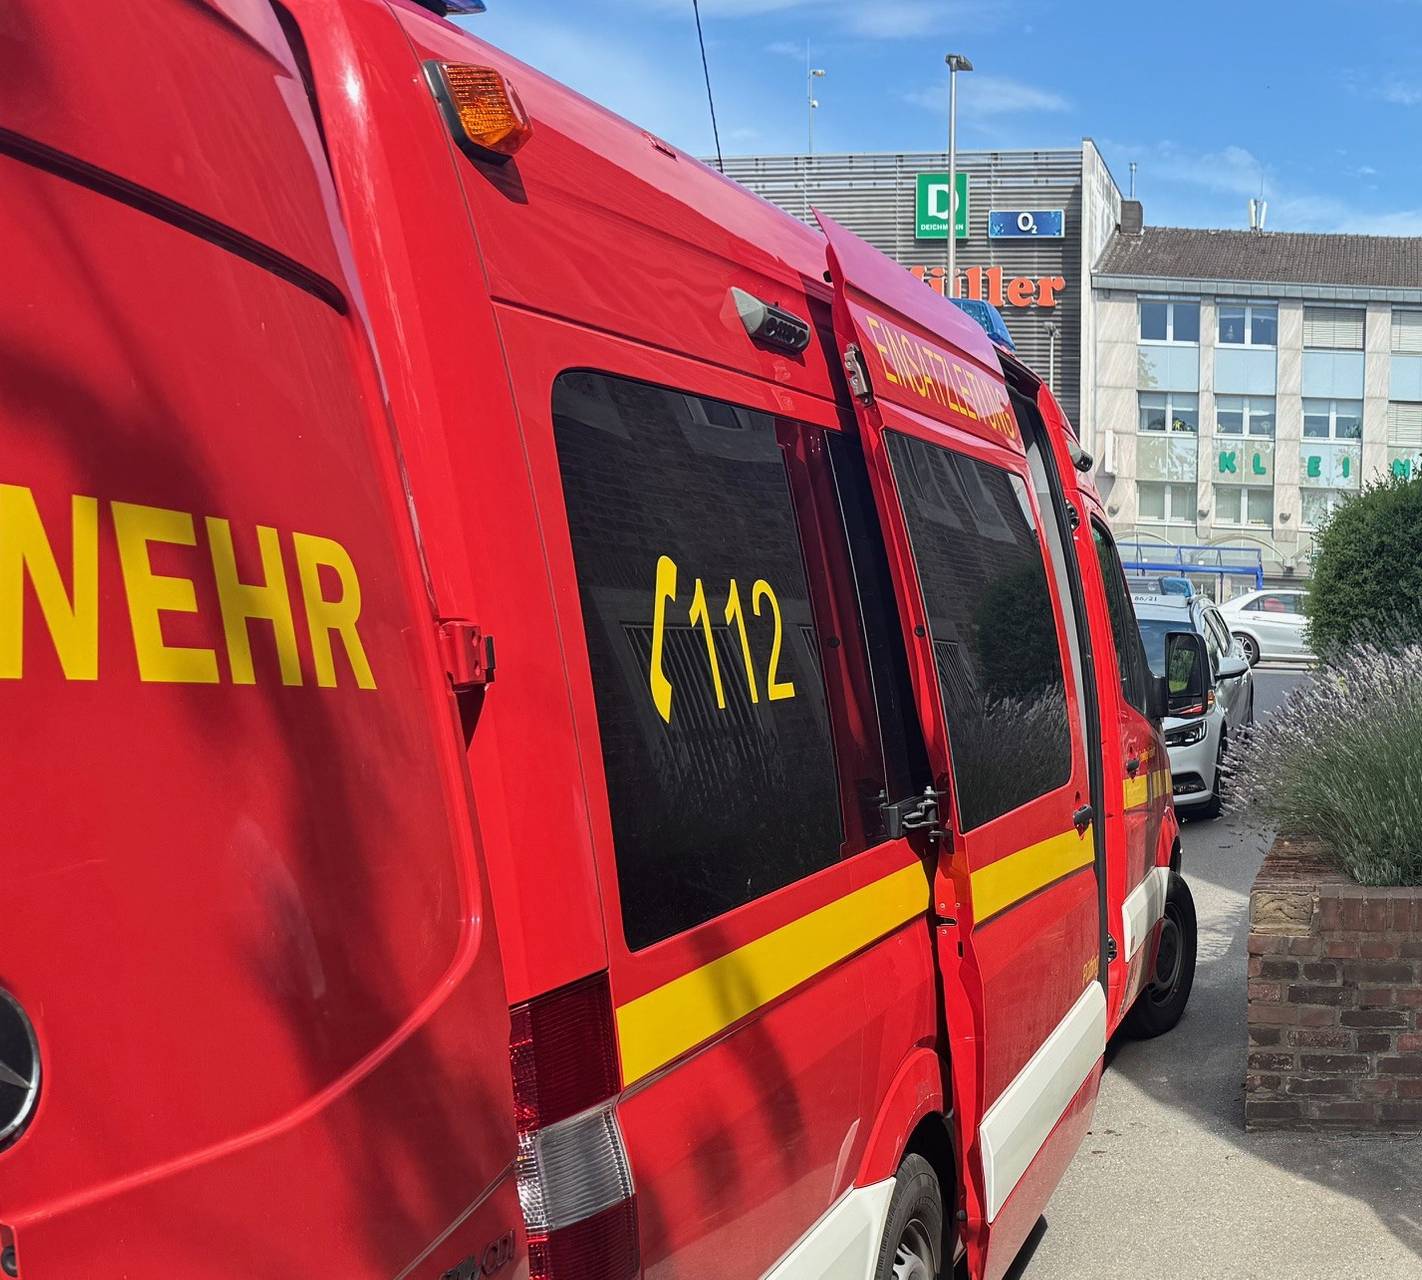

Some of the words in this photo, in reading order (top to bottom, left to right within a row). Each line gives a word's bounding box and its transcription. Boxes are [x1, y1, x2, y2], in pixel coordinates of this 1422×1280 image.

[920, 223, 964, 232] DEICHMN
[866, 315, 1016, 441] EINSATZLEITUNG
[688, 578, 796, 709] 112
